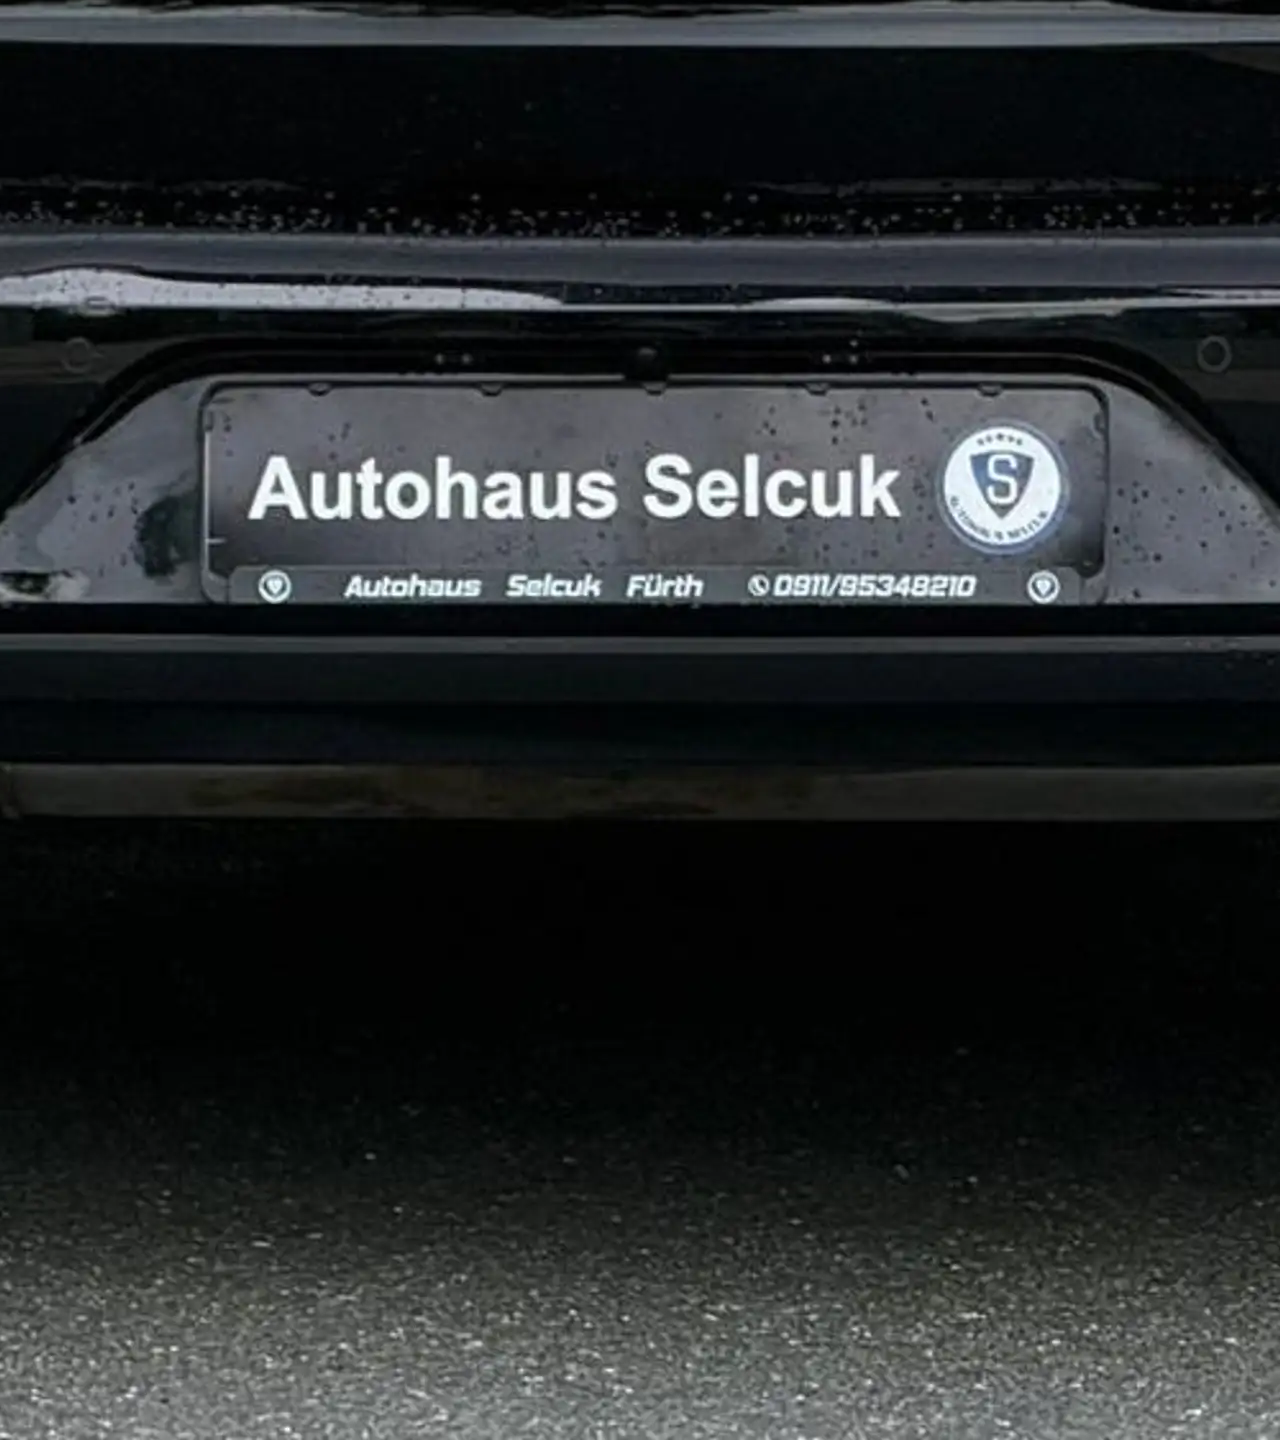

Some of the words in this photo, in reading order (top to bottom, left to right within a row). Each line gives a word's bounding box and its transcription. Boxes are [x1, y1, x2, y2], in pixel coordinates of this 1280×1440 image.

[247, 455, 618, 521] Autohaus
[642, 453, 901, 520] Selcuk
[344, 573, 482, 598] Autohaus
[505, 573, 602, 598] Selcuk
[626, 572, 705, 598] Fürth
[774, 573, 978, 598] 0911/95348210
